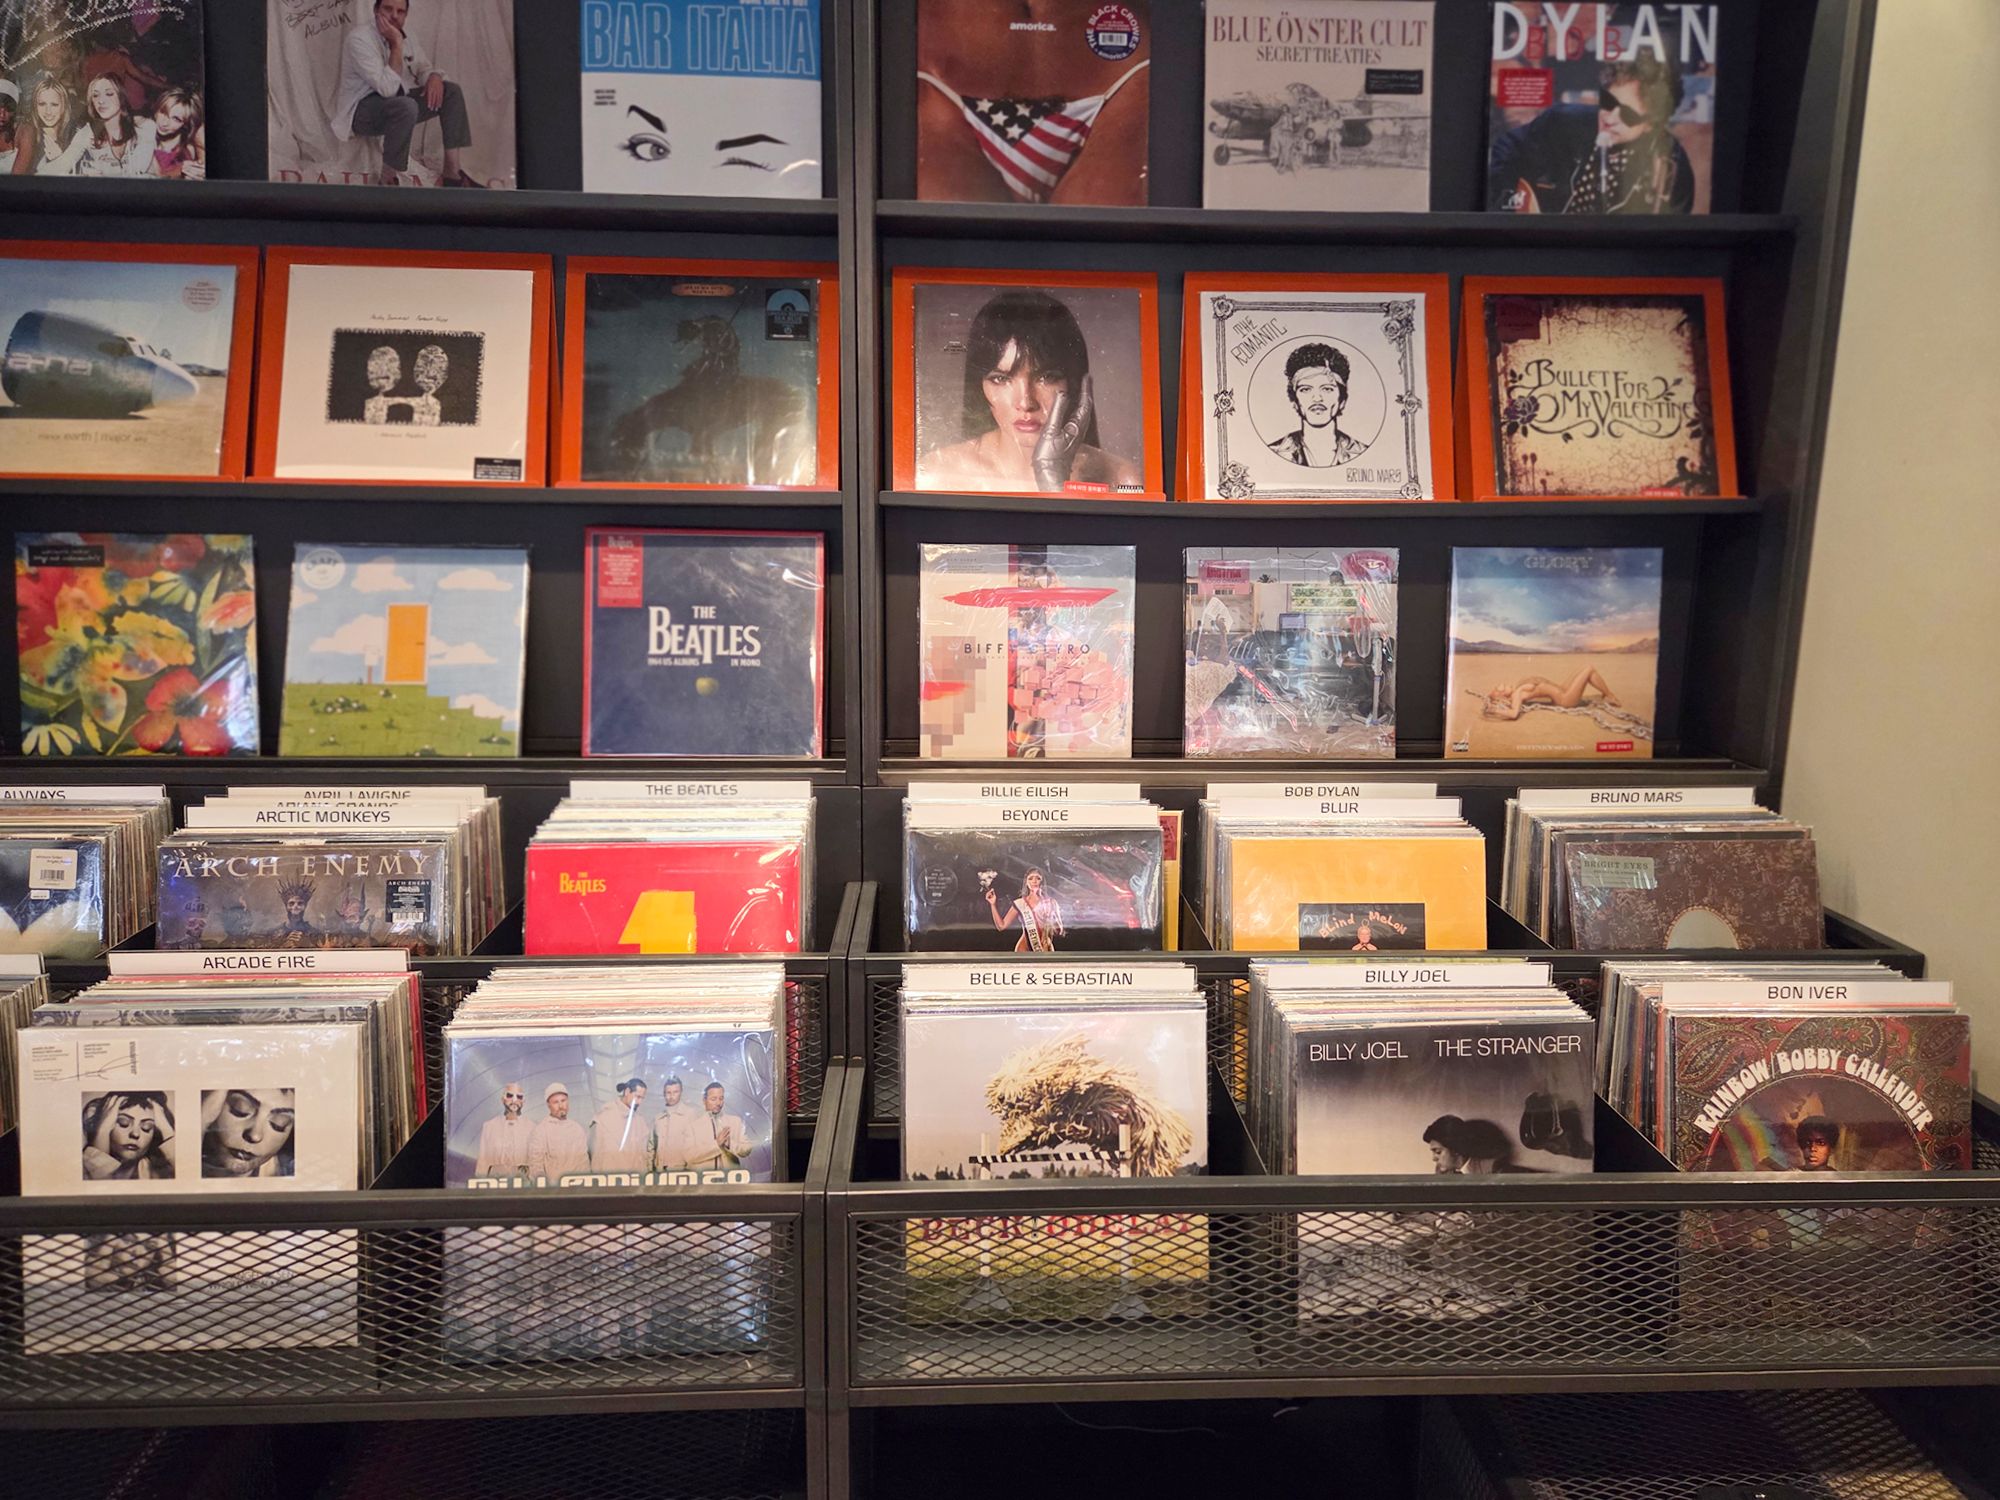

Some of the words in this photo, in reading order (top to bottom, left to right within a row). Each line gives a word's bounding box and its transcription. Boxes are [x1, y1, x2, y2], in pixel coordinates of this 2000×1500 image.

[304, 12, 352, 40] ALBUM
[1010, 22, 1056, 32] amorica.
[1213, 16, 1272, 43] BLUE
[1276, 11, 1362, 46] ÖYSTER
[1370, 20, 1428, 47] CULT
[1492, 1, 1718, 64] DYLAN
[583, 1, 672, 69] BAR
[687, 4, 816, 76] ITALIA
[1233, 316, 1258, 338] THE
[1231, 318, 1288, 366] ROMANTIC
[692, 605, 717, 619] THE
[647, 602, 762, 665] BEATLES
[646, 785, 673, 796] THE
[677, 785, 739, 796] BEATLES
[981, 786, 1022, 797] BILLIE
[1026, 786, 1068, 797] EILISH
[1284, 786, 1313, 797] BOB
[1317, 786, 1360, 797] DYLAN
[1590, 792, 1640, 804] BRUNO
[1643, 791, 1683, 803] MARS
[1320, 802, 1358, 814] BLUR
[255, 811, 311, 823] ARCTIC
[315, 811, 391, 823] MONKEYS
[1002, 809, 1069, 821] BEYONCE
[174, 856, 281, 878] ARCH
[301, 854, 431, 878] ENEMY
[1583, 860, 1621, 869] BRIGHT
[1623, 861, 1649, 870] EYES
[559, 872, 607, 896] BEATLES
[203, 956, 272, 969] ARCADE
[277, 955, 316, 968] FIRE
[970, 973, 1021, 985] BELLE
[1026, 973, 1038, 985] &
[1042, 972, 1132, 985] SEBASTIAN
[1365, 970, 1408, 982] BILLY
[1411, 970, 1451, 983] JOEL
[1767, 986, 1802, 999] BON
[1808, 986, 1847, 999] IVER
[1309, 1043, 1357, 1062] BILLY
[1360, 1040, 1408, 1059] JOEL
[1433, 1039, 1473, 1058] THE
[1477, 1034, 1582, 1056] STRANGER
